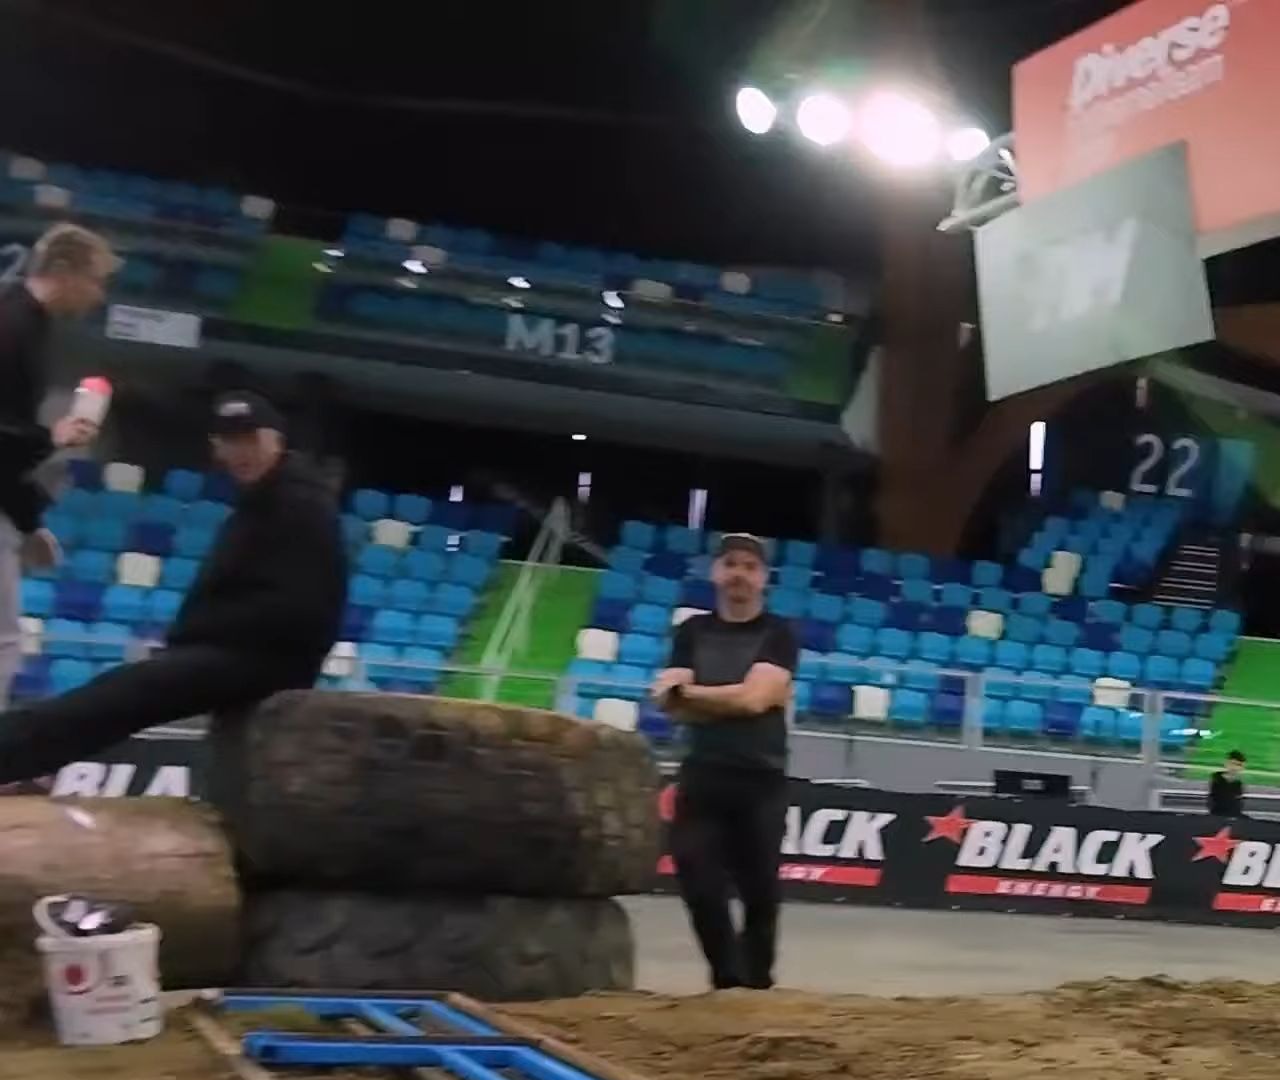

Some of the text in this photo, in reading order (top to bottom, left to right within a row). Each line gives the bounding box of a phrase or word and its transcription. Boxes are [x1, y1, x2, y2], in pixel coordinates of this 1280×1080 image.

[1072, 4, 1230, 107] Diverse
[505, 313, 614, 364] M13
[1129, 433, 1199, 497] 22
[955, 820, 1167, 880] BLACK
